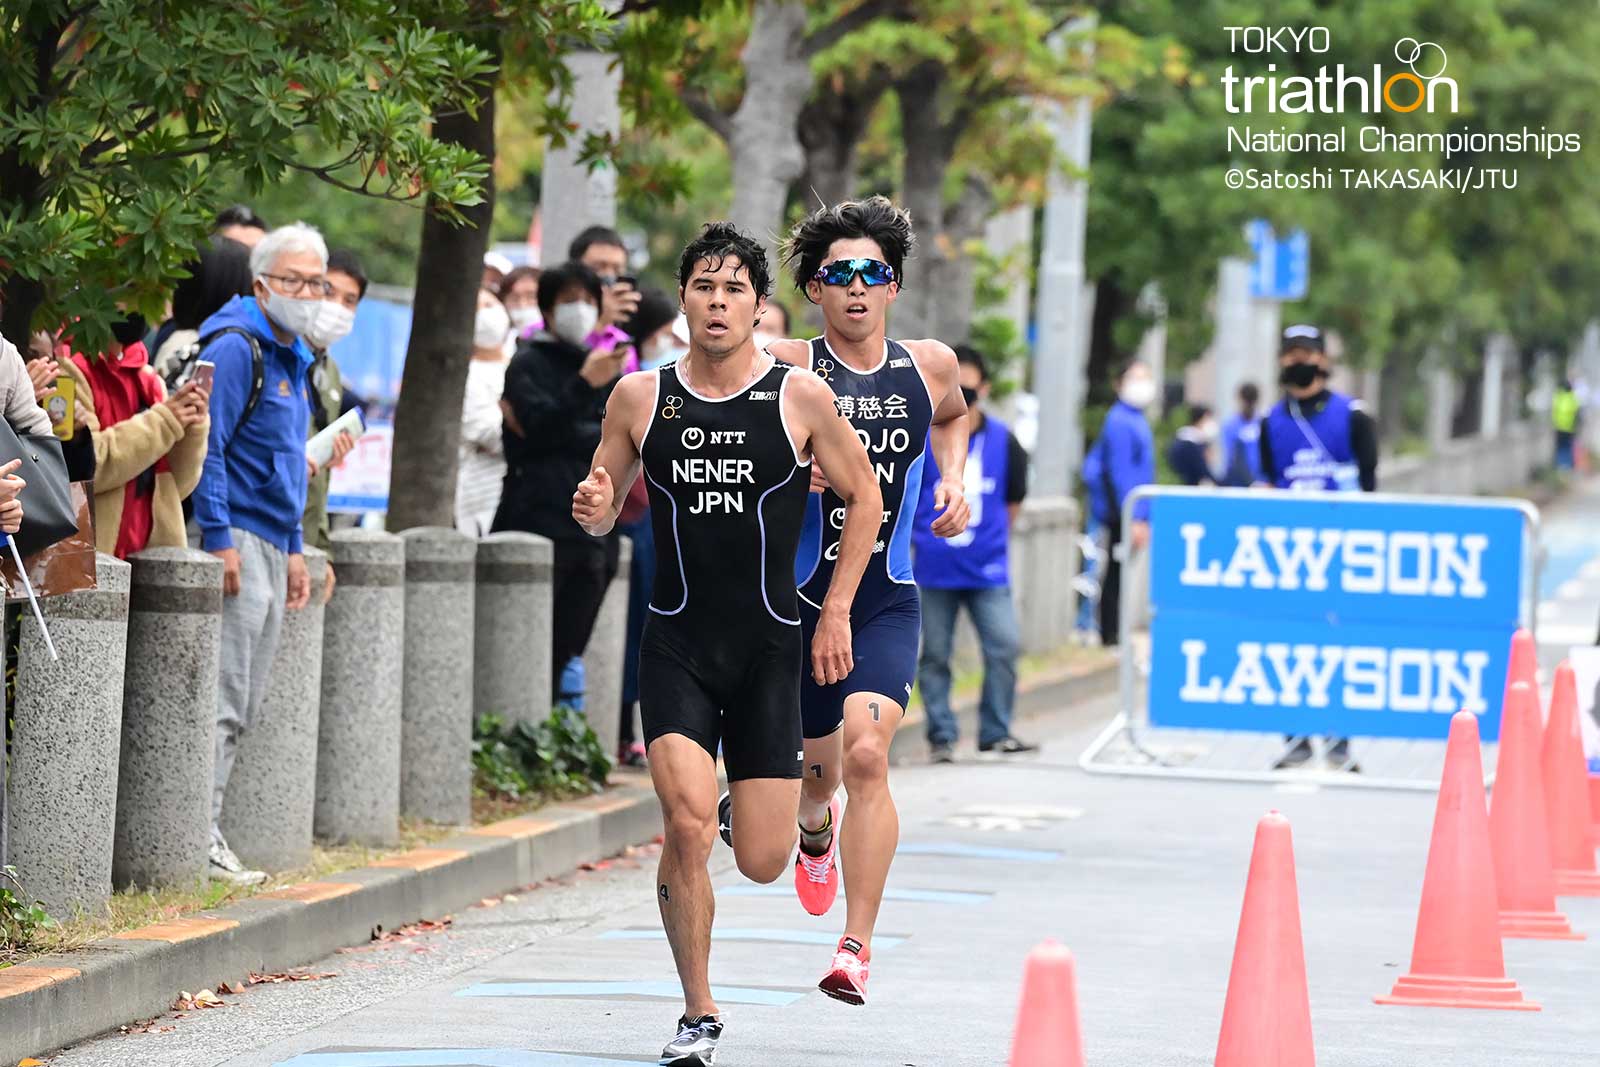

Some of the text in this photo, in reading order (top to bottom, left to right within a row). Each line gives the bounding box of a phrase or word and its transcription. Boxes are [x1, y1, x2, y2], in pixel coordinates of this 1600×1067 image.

[709, 431, 747, 445] NTT
[855, 428, 910, 454] OJO
[671, 458, 756, 484] NENER
[689, 491, 744, 515] JPN
[1180, 523, 1489, 599] LAWSON
[1179, 639, 1489, 715] LAWSON
[868, 702, 881, 722] 1
[810, 764, 823, 779] 1
[659, 883, 670, 902] 4
